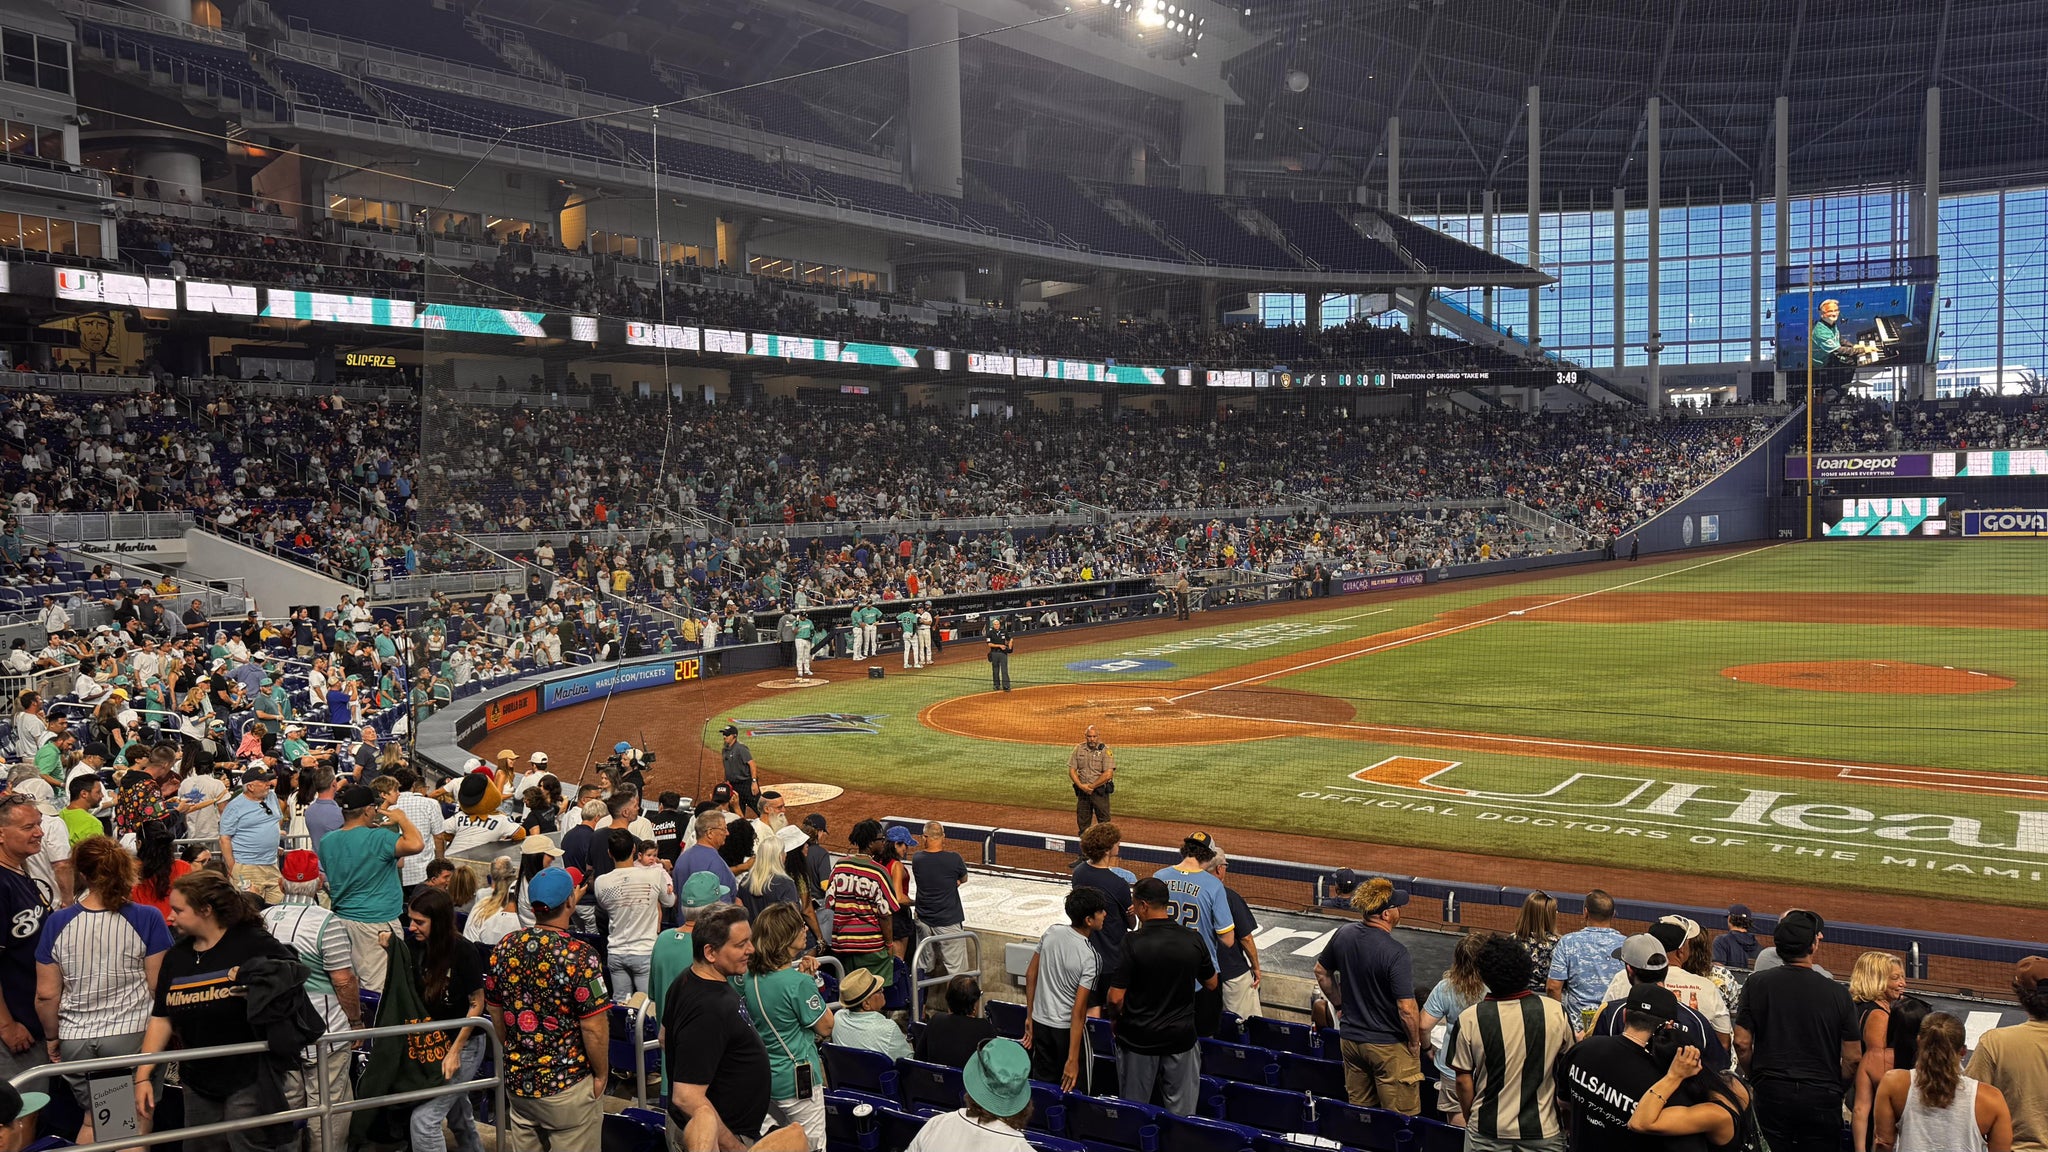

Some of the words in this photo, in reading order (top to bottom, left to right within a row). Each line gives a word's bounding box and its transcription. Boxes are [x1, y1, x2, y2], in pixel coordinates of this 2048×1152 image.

[1436, 372, 1460, 380] SINGING
[1556, 372, 1577, 385] 3:49
[1816, 456, 1898, 470] loanDepot
[1983, 514, 2044, 530] GOYA
[1778, 529, 1793, 538] 344
[115, 542, 157, 552] Marlins
[552, 682, 590, 704] Marlins
[1297, 791, 1459, 817] OFFICIAL
[1476, 811, 1672, 840] DOCTORS
[1689, 835, 1750, 849] OF
[1766, 842, 1858, 863] THE
[1881, 855, 2042, 882] MIAMI
[165, 986, 231, 1006] Milwauke
[93, 1082, 129, 1100] Clubhouse
[1568, 1063, 1639, 1115] ALLSAINTS
[94, 1100, 107, 1108] Box
[98, 1108, 111, 1126] 9
